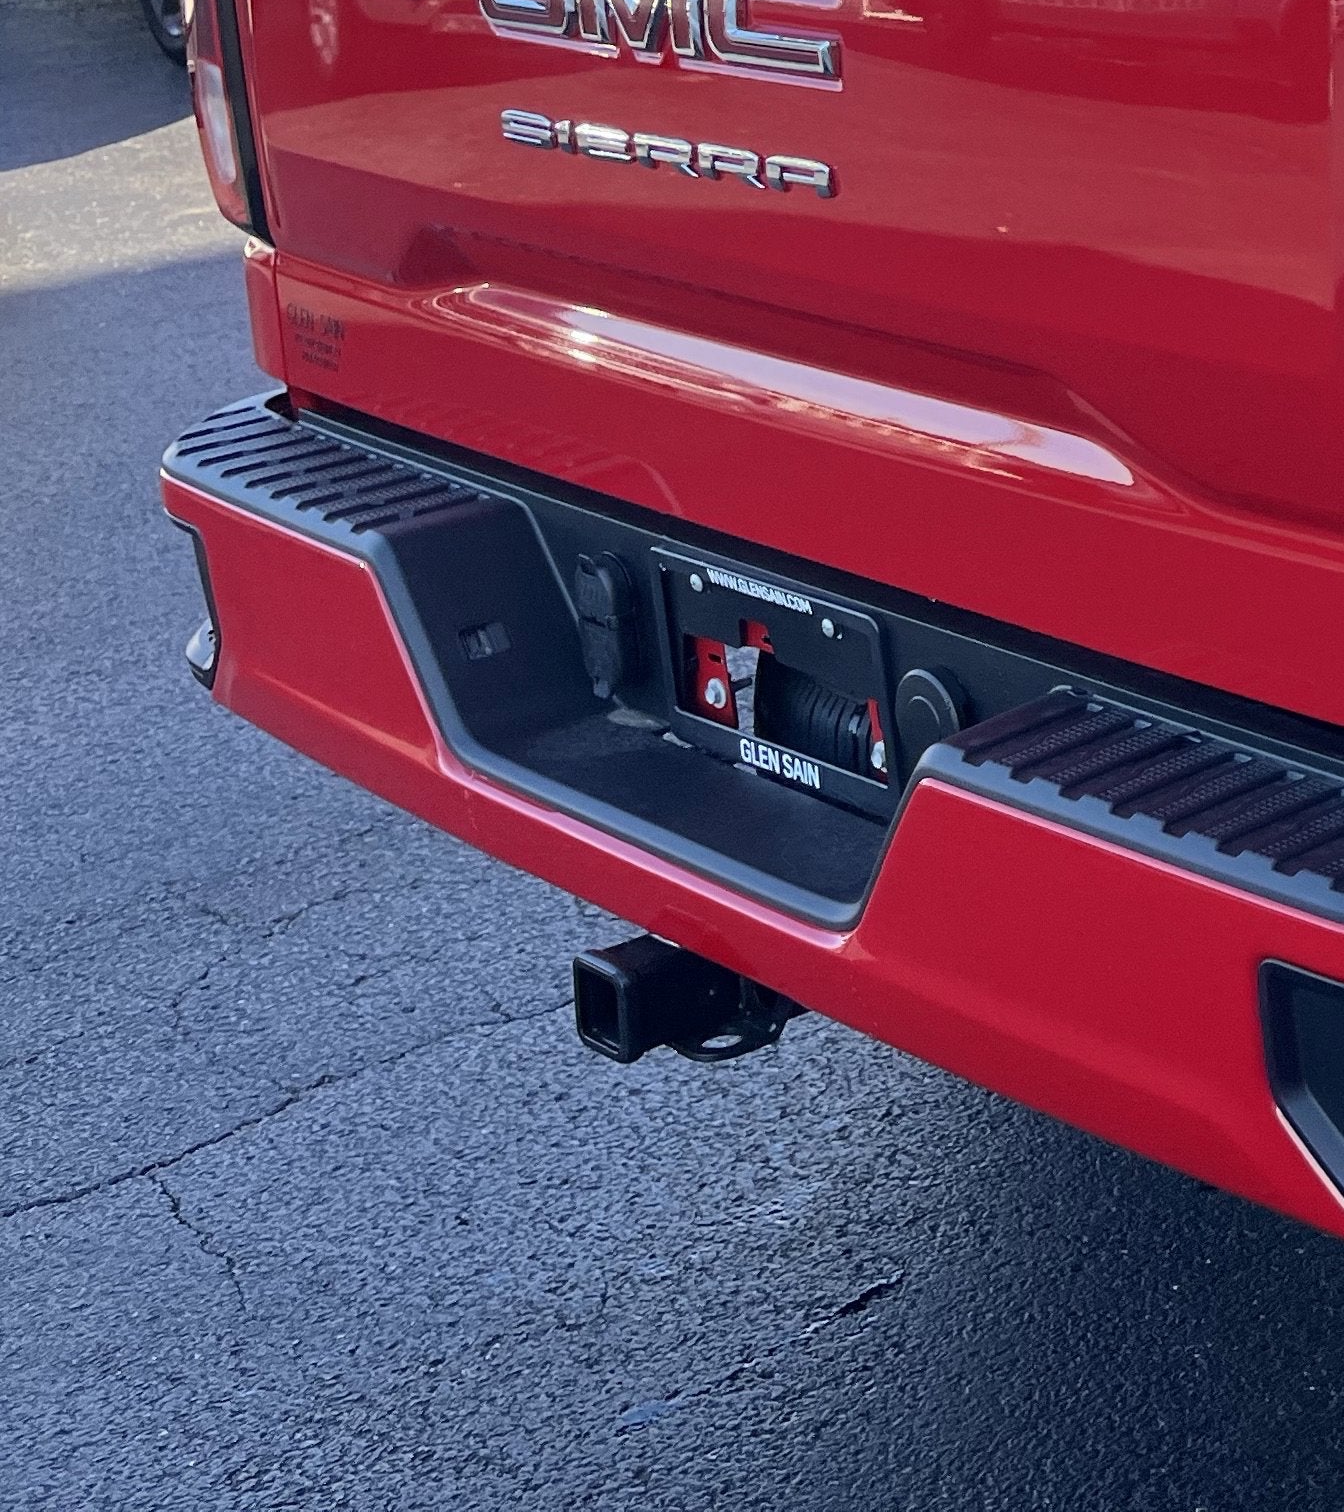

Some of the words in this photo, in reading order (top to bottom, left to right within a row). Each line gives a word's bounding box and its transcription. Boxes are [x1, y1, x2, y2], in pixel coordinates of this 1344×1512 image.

[501, 108, 838, 199] SIERRA
[706, 569, 812, 614] WWW.GLENSAIN.COM
[740, 738, 780, 774] GLEN
[782, 756, 820, 789] SAIN
